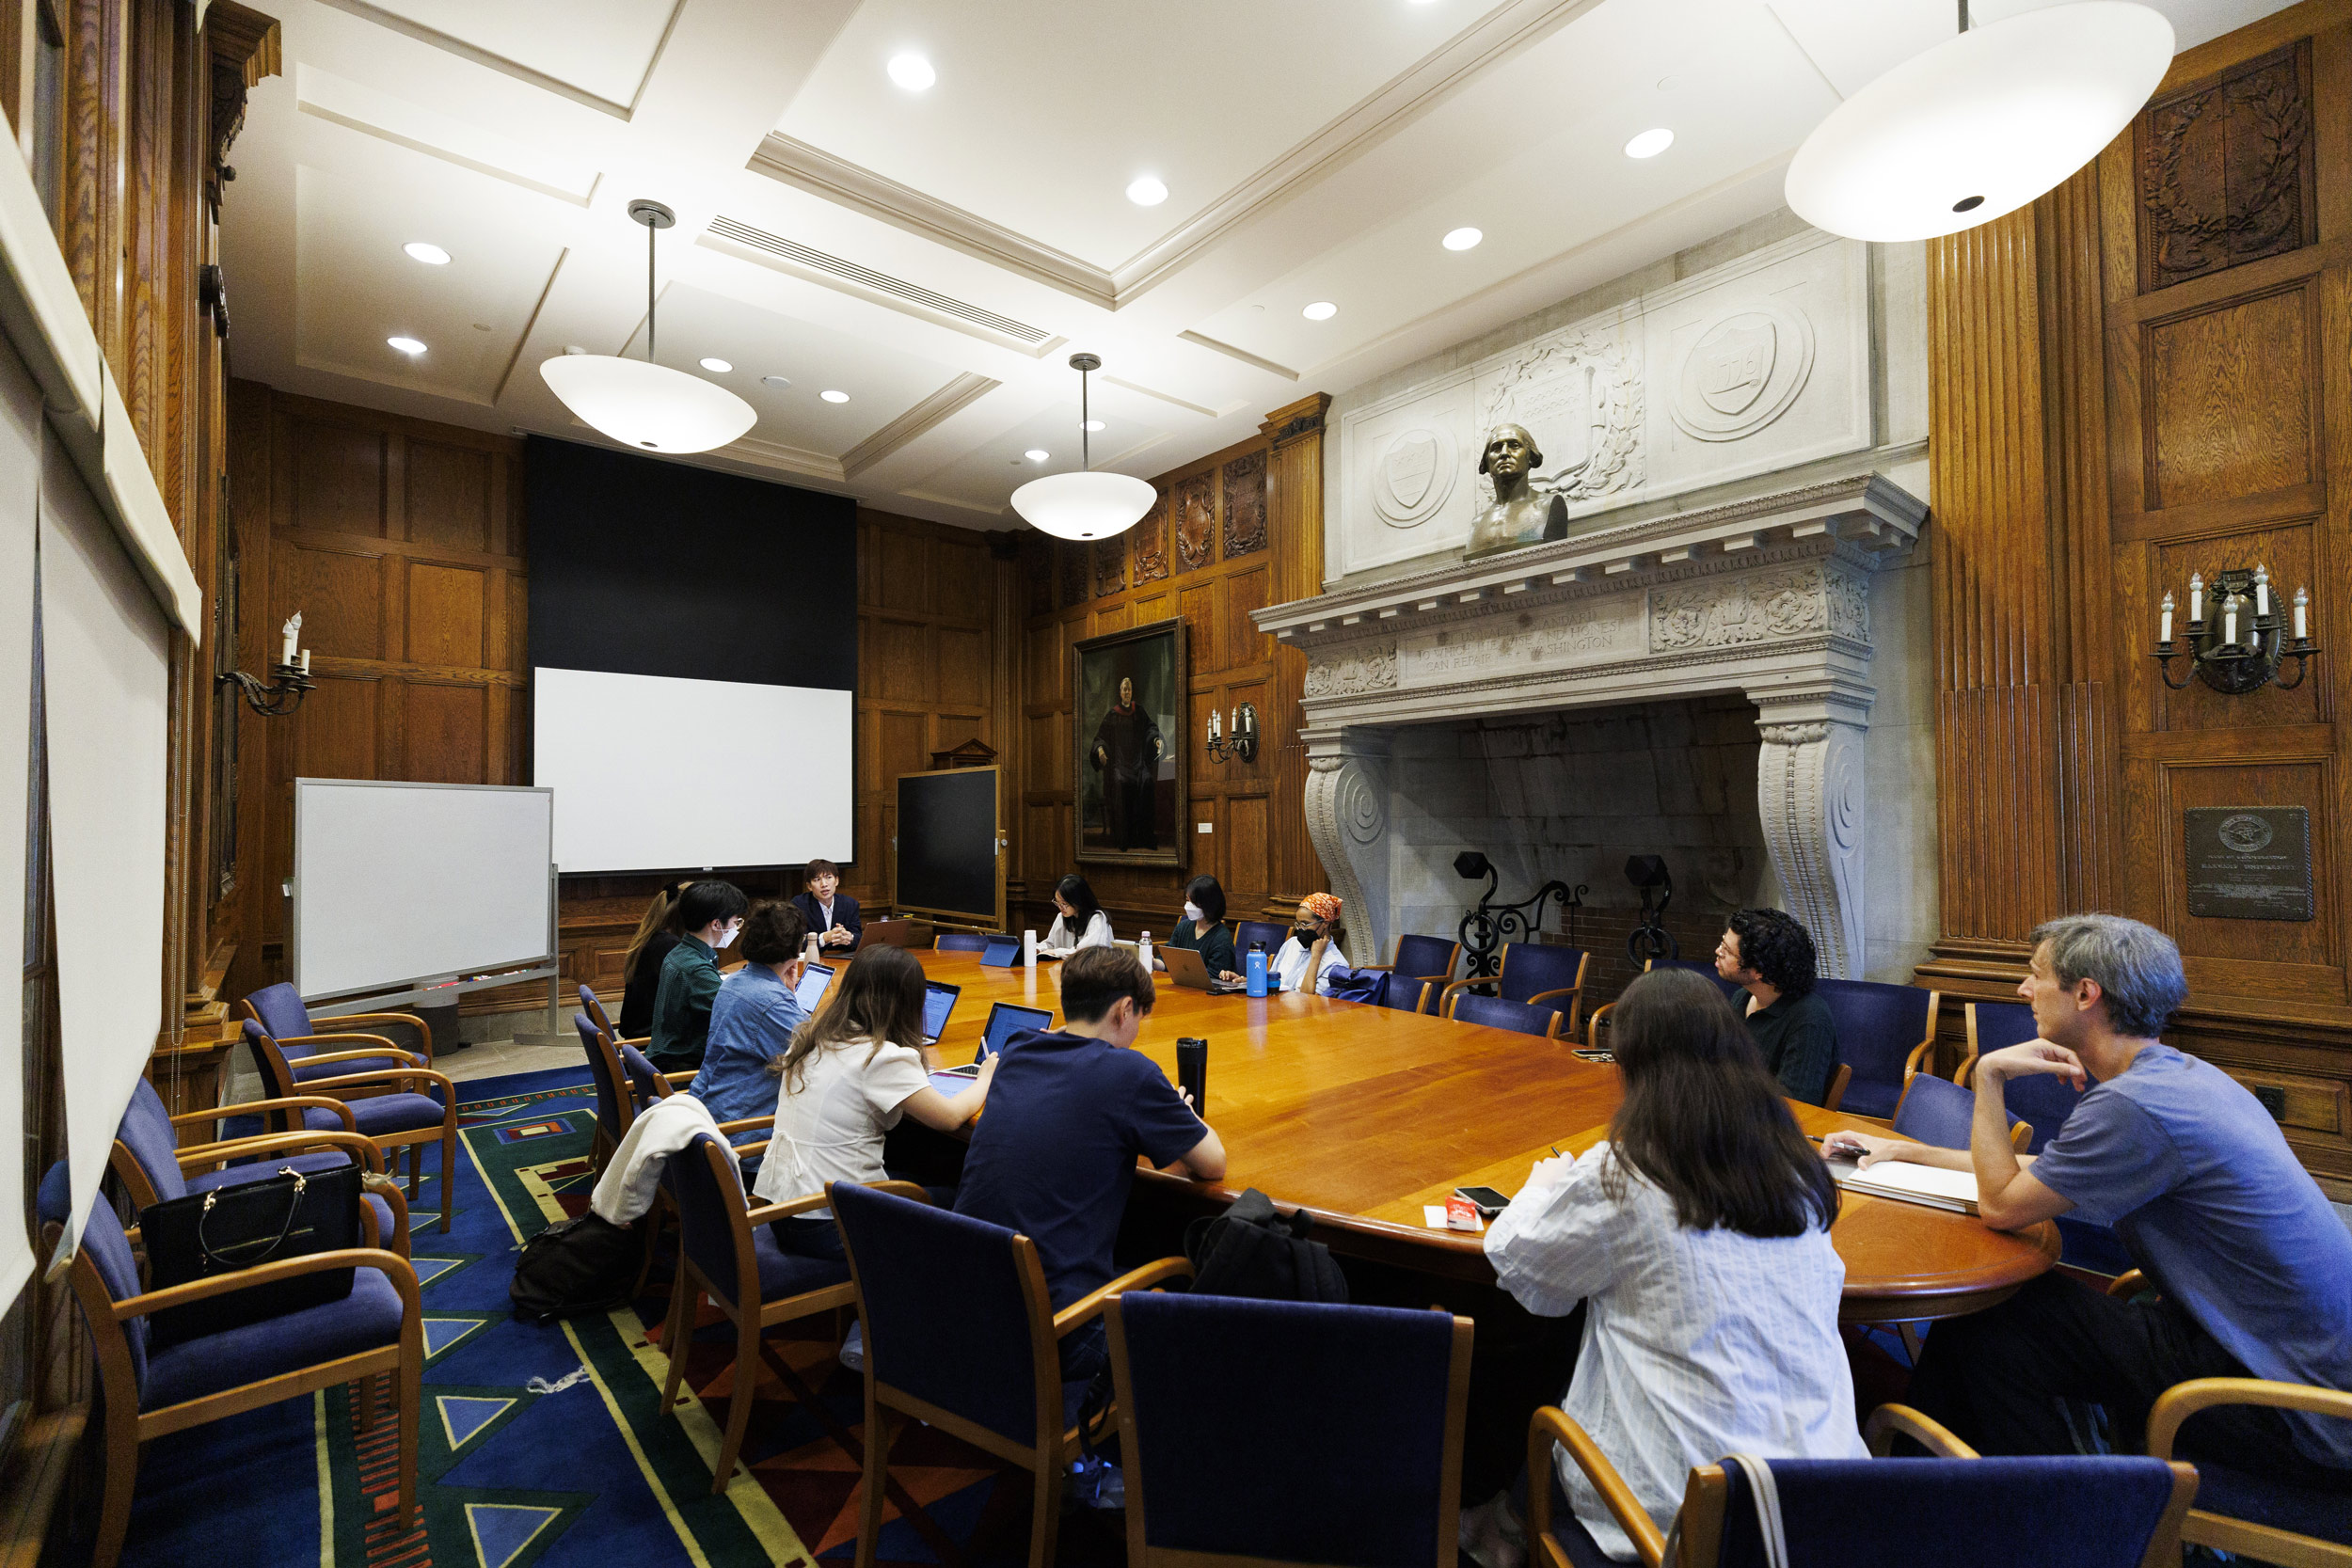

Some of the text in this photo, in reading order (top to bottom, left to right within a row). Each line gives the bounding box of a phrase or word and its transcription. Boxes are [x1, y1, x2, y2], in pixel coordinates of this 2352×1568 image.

[1417, 649, 1430, 661] TO
[1434, 643, 1470, 658] WHICH
[1476, 640, 1499, 652] THE
[1537, 629, 1565, 643] AND
[1570, 618, 1624, 638] HONEST
[1461, 631, 1475, 641] US
[1530, 610, 1597, 631] STANDARD
[1426, 635, 1613, 672] CAN REPAIR WASHINGTON
